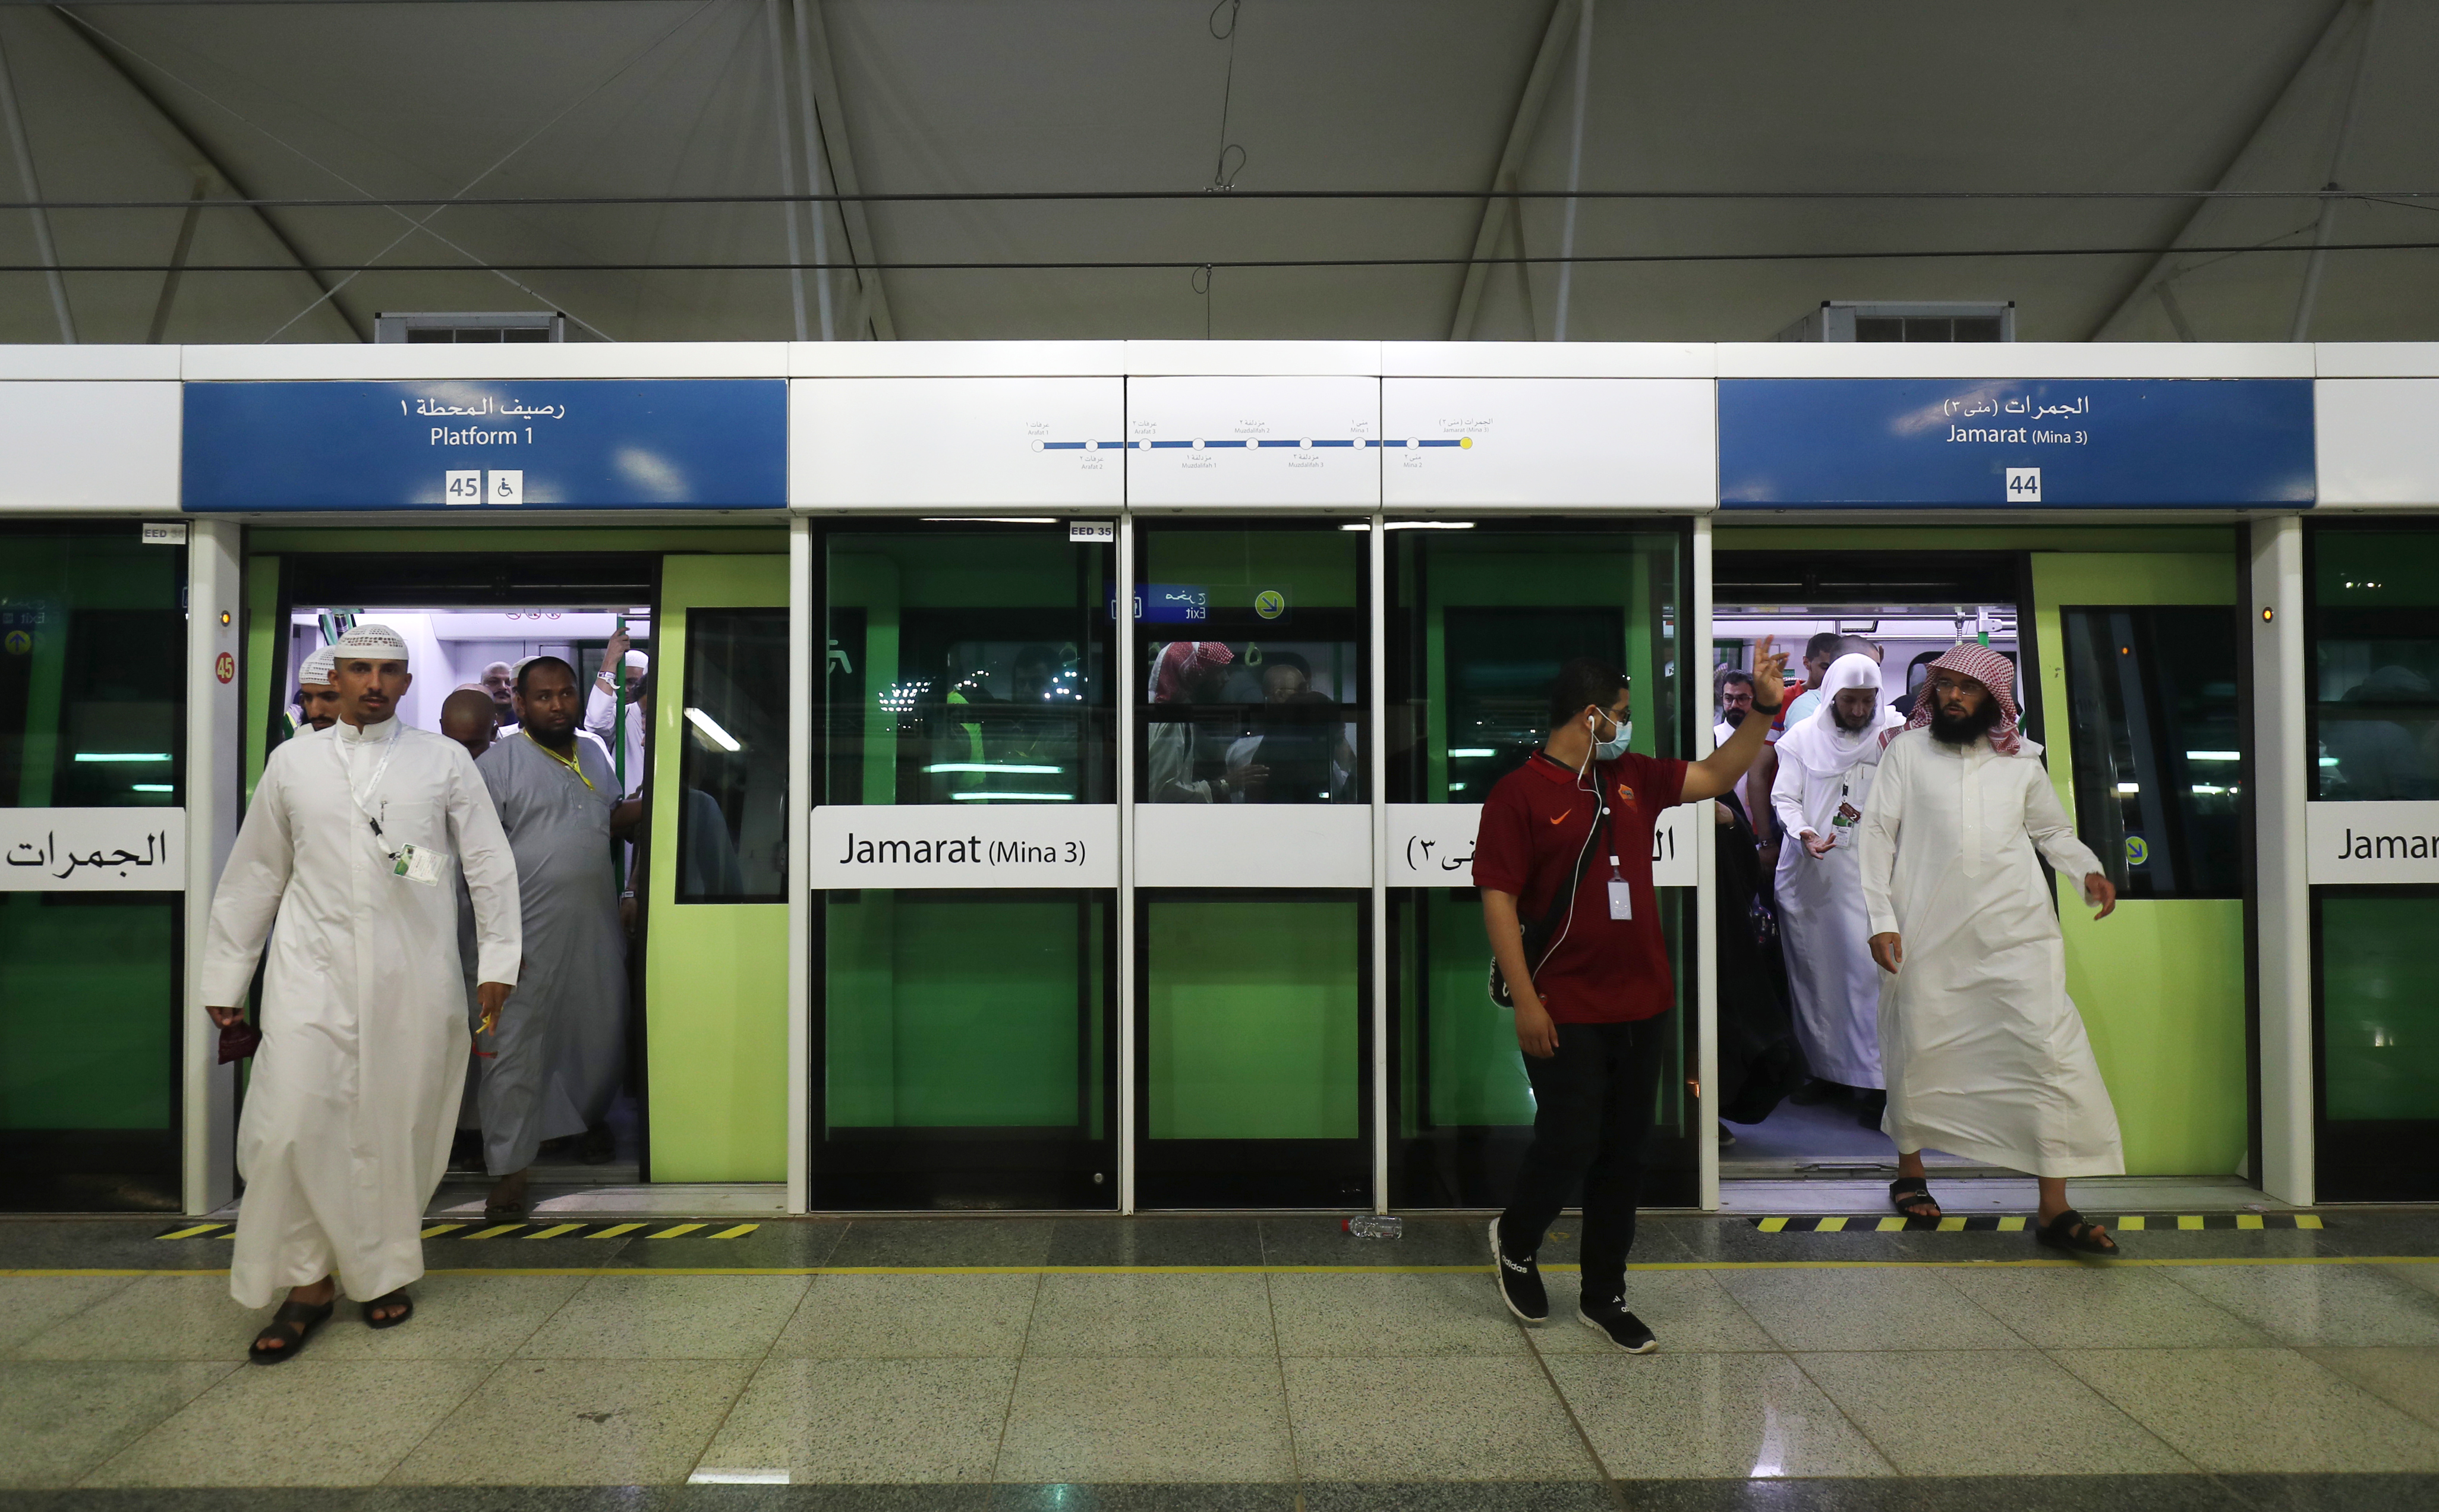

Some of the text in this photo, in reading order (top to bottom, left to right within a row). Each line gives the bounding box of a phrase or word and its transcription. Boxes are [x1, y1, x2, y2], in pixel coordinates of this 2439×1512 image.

[417, 396, 493, 416] المحطة
[500, 398, 565, 419] رصيف
[2005, 395, 2089, 420] الجمرات
[1465, 418, 1493, 426] الجمرات
[431, 427, 532, 445] Platform 1
[1947, 425, 2088, 445] Jamarat (Mina 3)
[449, 478, 477, 496] 45
[2009, 475, 2037, 494] 44
[144, 528, 168, 538] EED
[1072, 527, 1112, 536] EED 35
[217, 657, 233, 679] 45
[7, 830, 166, 879] الجمرات
[840, 833, 1086, 866] Jamarat (Mina 3)
[1501, 1255, 1527, 1273] adidas
